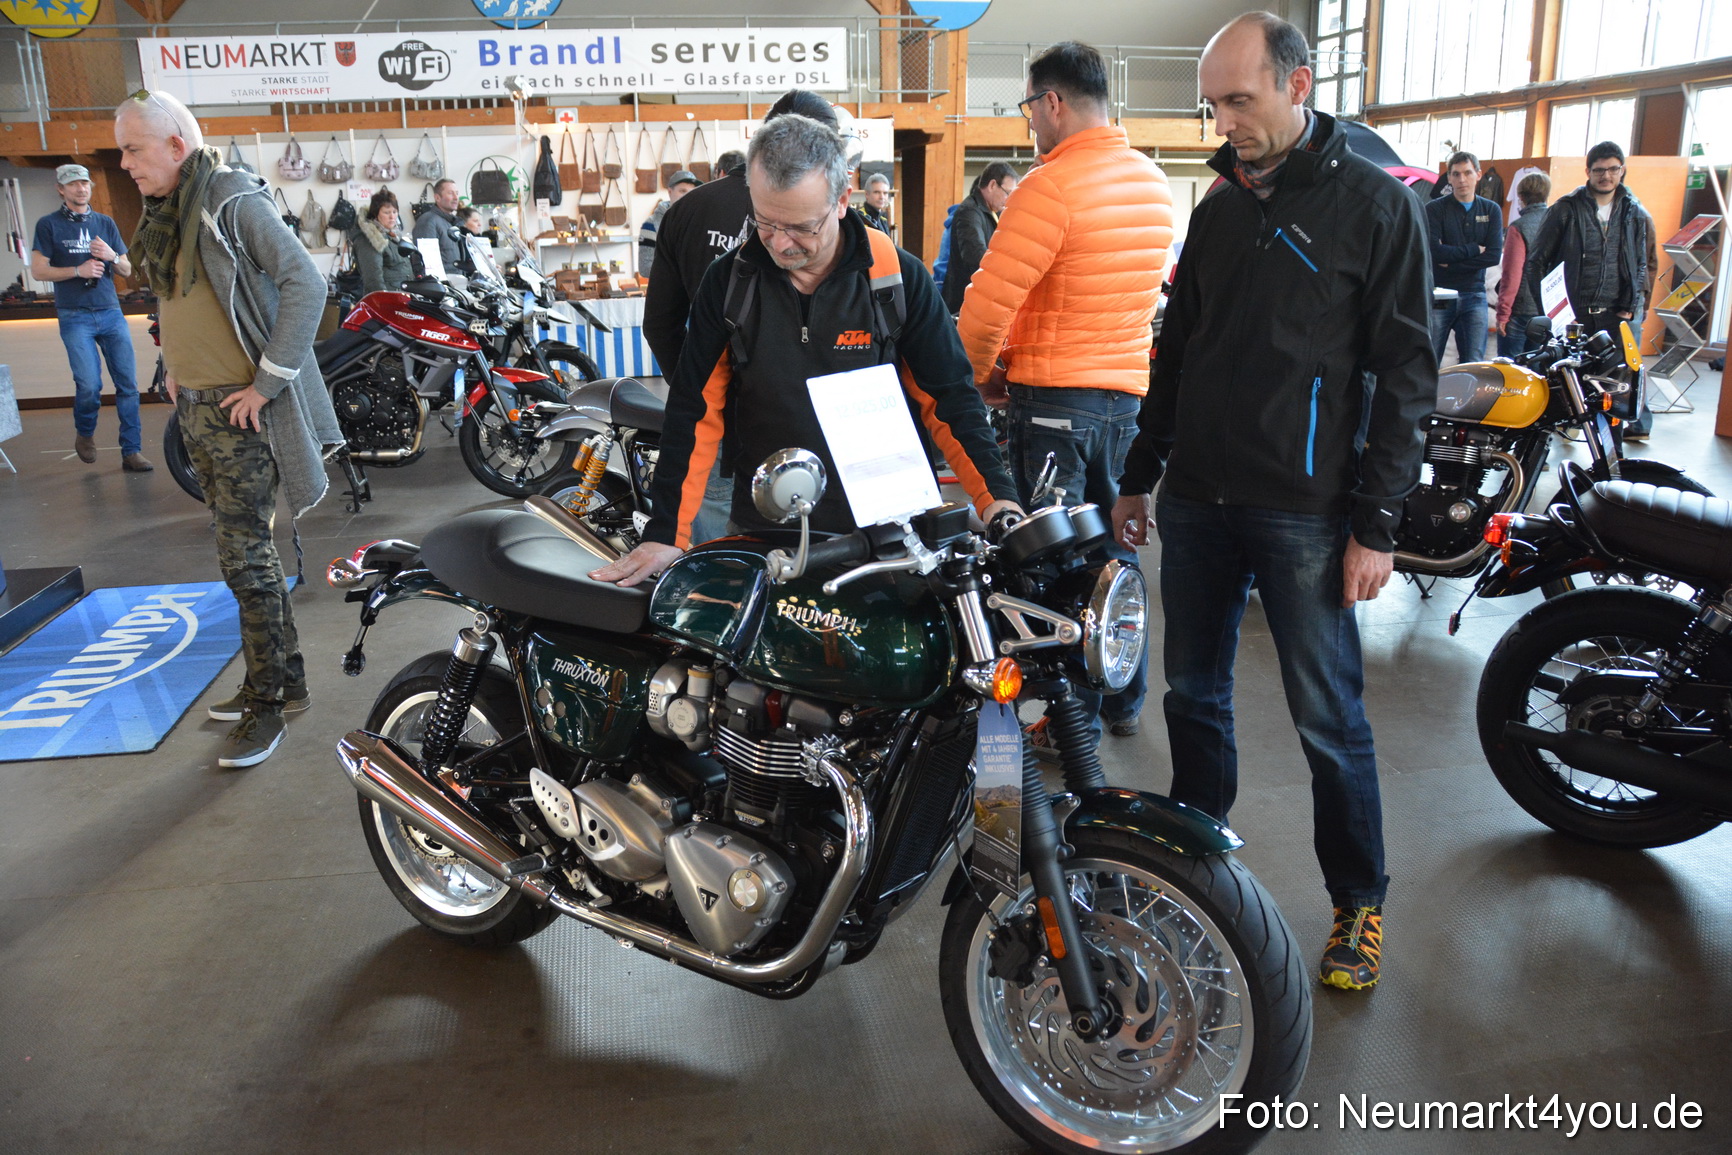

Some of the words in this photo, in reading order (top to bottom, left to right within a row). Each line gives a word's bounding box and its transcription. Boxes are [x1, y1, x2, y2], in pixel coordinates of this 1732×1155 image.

[402, 42, 424, 51] FREE
[478, 36, 622, 67] Brandl
[651, 35, 830, 63] services
[160, 42, 326, 70] NEUMARKT
[261, 77, 298, 85] STARKE
[301, 75, 329, 84] STADT
[481, 74, 564, 90] eiach
[574, 72, 654, 88] schnell
[684, 71, 786, 86] Glasfaser
[795, 72, 830, 85] DSL
[231, 89, 266, 97] STARKE
[270, 87, 331, 96] WIRTSCHAFT
[394, 310, 424, 321] TRIUMPH
[420, 329, 451, 342] TIGER
[836, 330, 872, 346] KTM
[776, 602, 857, 632] TRIUMPH
[0, 591, 209, 730] TRIUMPH
[551, 657, 611, 688] THRUXTON
[980, 735, 994, 744] ALLE
[995, 734, 1019, 743] MODELLE
[981, 745, 991, 753] MIT
